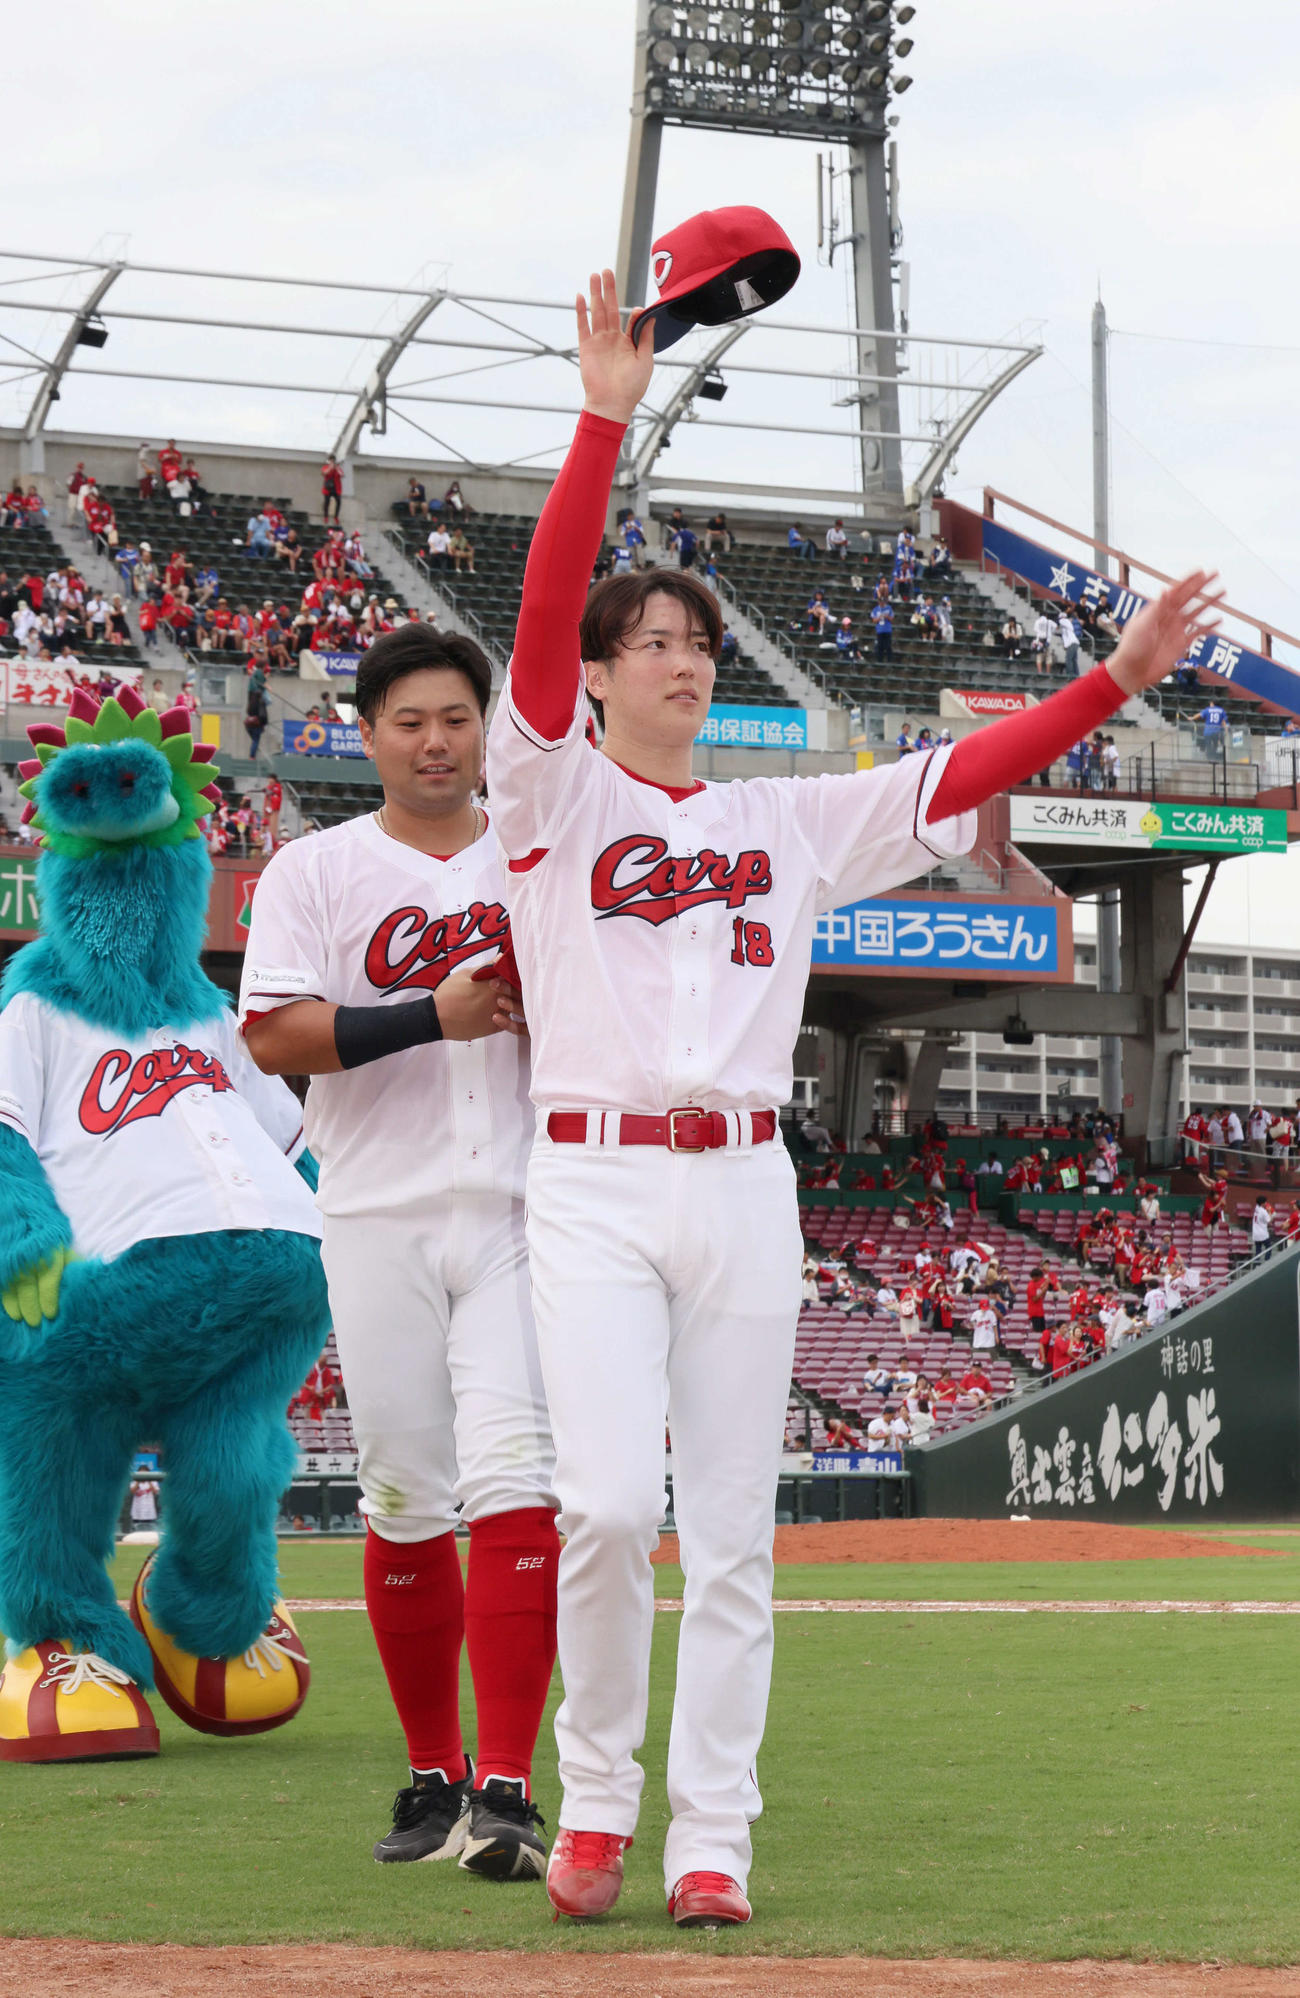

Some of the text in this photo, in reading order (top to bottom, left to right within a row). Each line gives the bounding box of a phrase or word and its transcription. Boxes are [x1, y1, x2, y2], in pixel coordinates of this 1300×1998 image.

[967, 696, 1025, 711] KAWADA
[1032, 804, 1128, 829] こくみん共済
[1171, 811, 1265, 837] こくみん共済
[591, 834, 772, 927] Carp
[731, 916, 775, 967] 18
[813, 908, 1048, 962] 中国ろうきん
[1160, 1335, 1215, 1379] 神話の里
[515, 1556, 547, 1571] 52
[384, 1573, 417, 1586] 52
